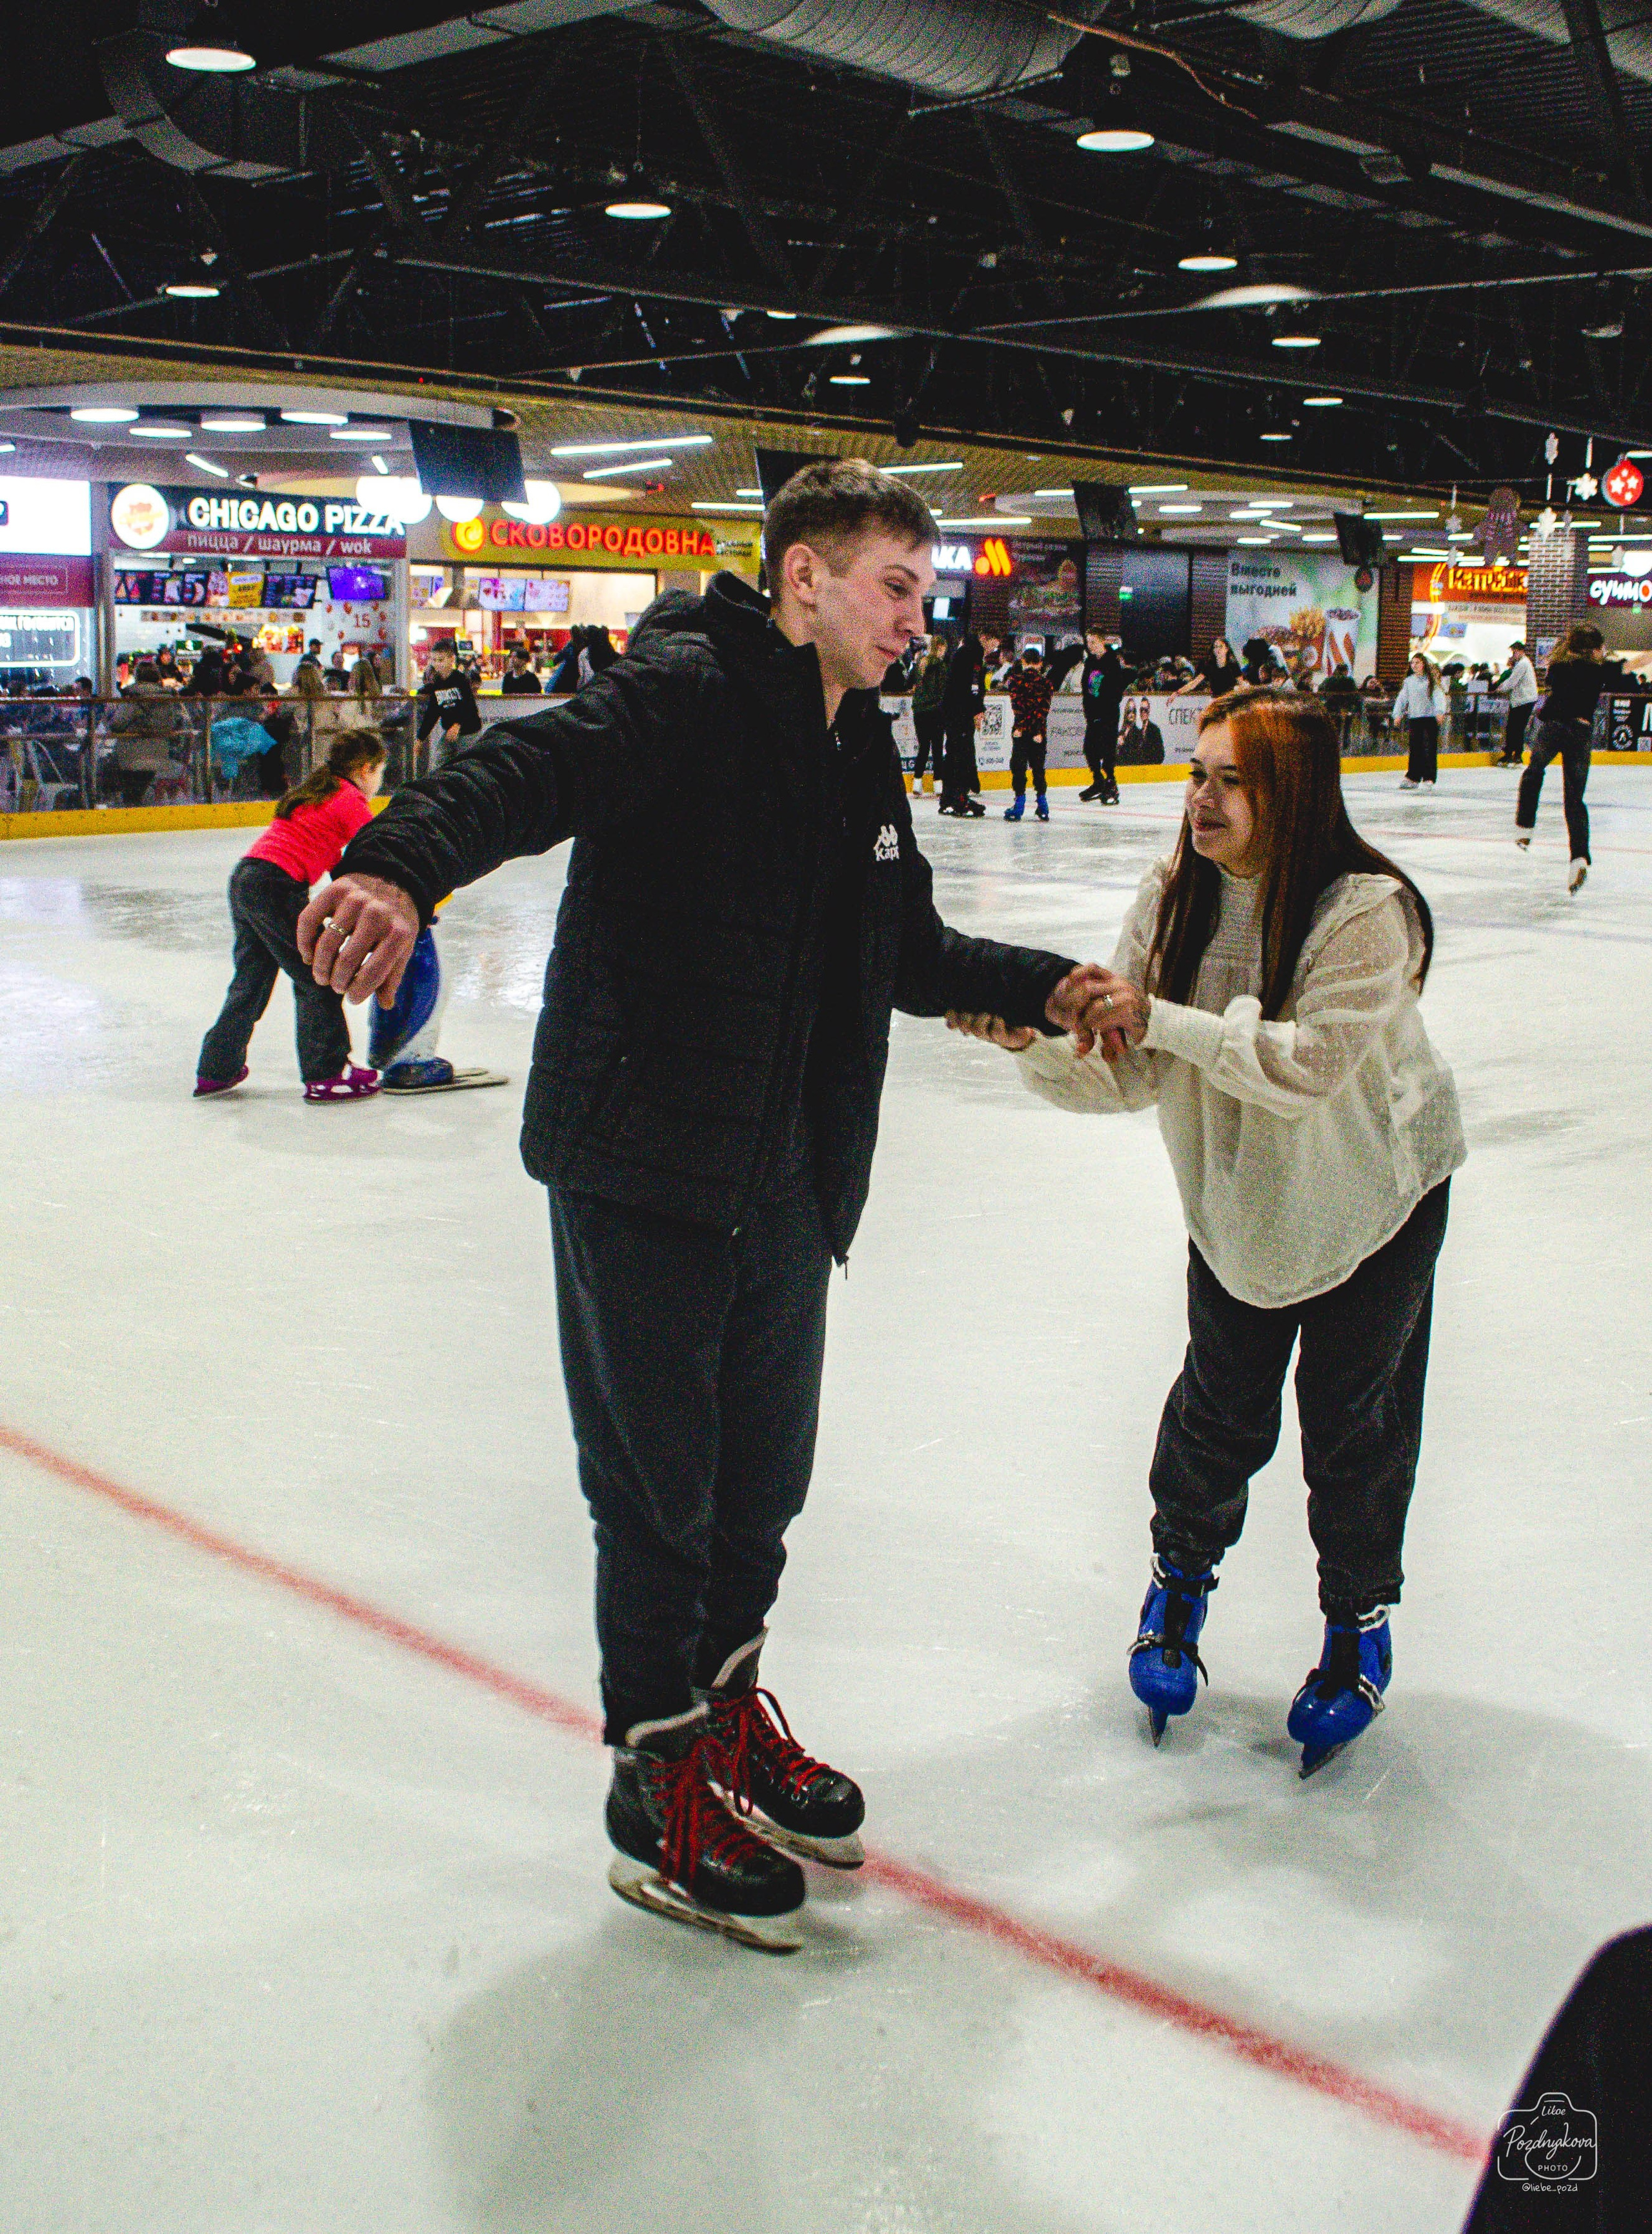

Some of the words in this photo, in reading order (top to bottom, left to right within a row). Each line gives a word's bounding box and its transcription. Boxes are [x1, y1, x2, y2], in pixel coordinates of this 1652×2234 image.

[188, 497, 319, 533] CHICAGO
[187, 534, 239, 551] пицца
[258, 538, 321, 554] шаурма
[341, 538, 372, 554] wok
[490, 518, 716, 558] СКОВОРОДОВНА
[1231, 563, 1280, 578] Вместе
[1231, 582, 1296, 598] выгодней
